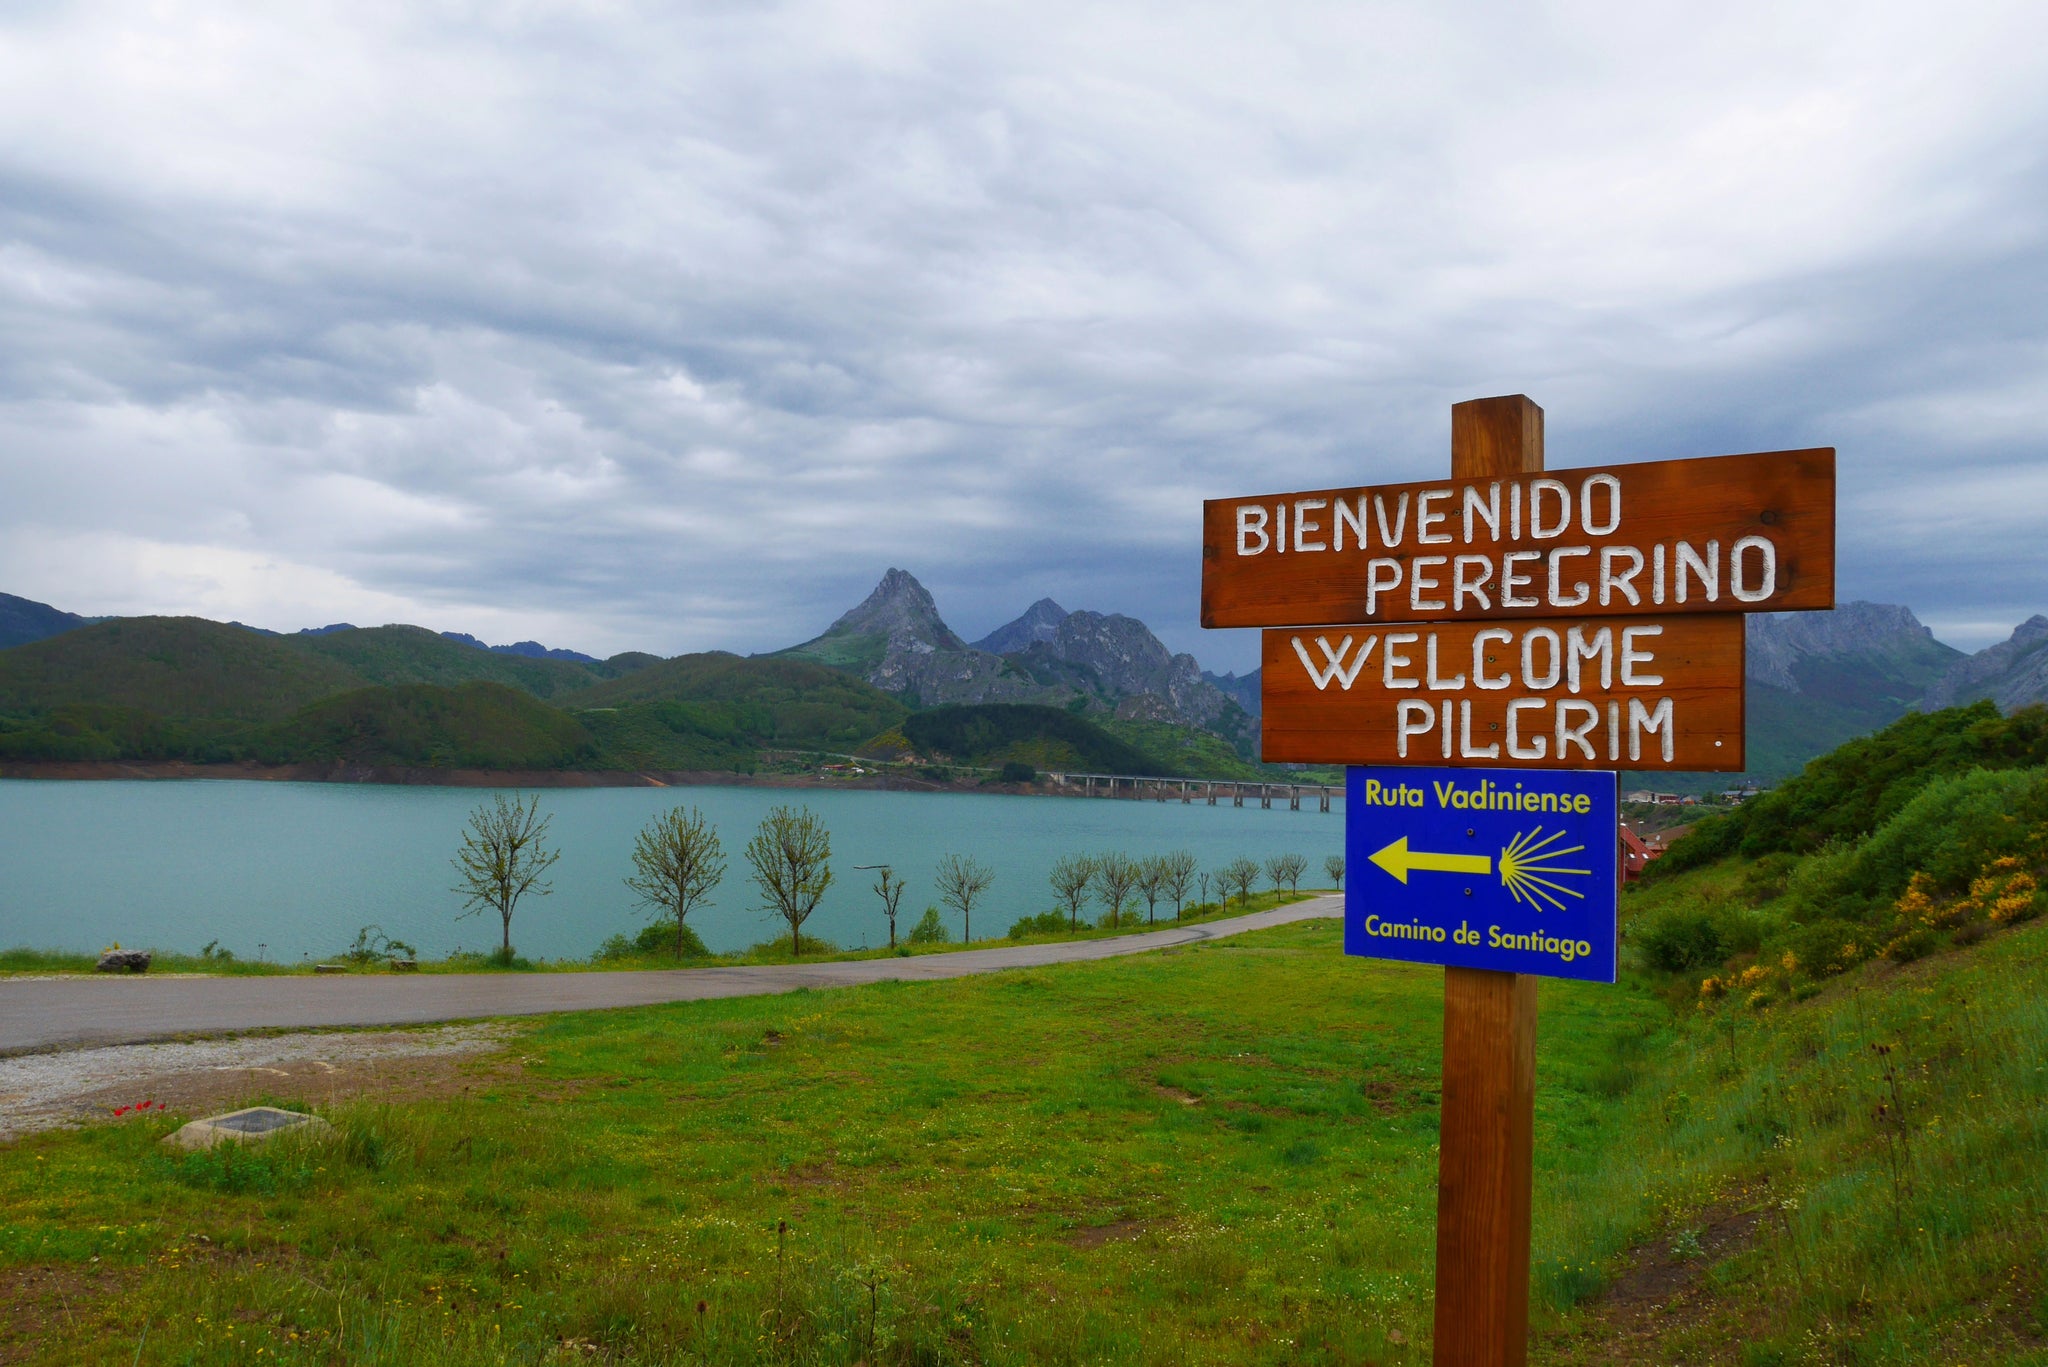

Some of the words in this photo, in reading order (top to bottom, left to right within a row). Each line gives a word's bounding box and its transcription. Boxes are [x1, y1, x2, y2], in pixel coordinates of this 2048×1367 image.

[1236, 473, 1621, 555] BIENVENIDO
[1366, 535, 1776, 615] PEREGRINO
[1290, 624, 1664, 693] WELCOME
[1398, 697, 1674, 763] PILGRIM
[1365, 779, 1424, 807] Ruta
[1433, 779, 1591, 814] Vadiniense
[1365, 914, 1446, 943] Camino
[1453, 920, 1480, 946] de
[1488, 925, 1591, 962] Santiago
